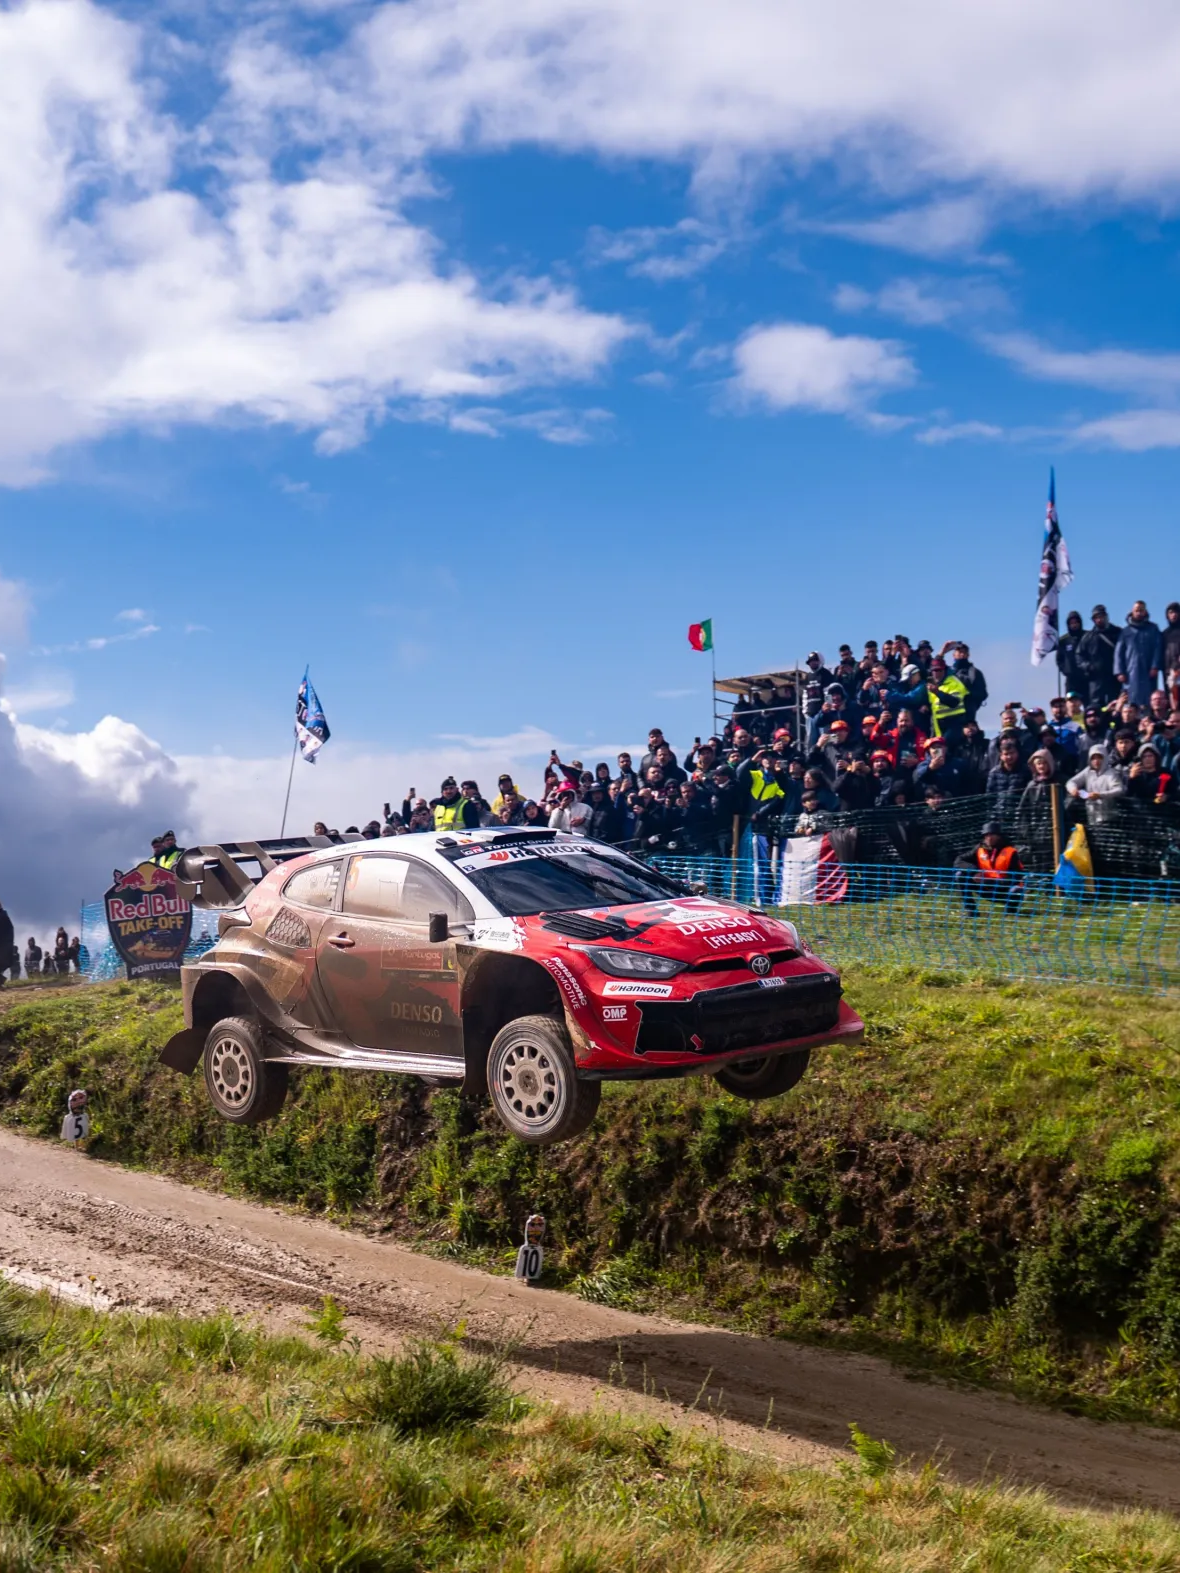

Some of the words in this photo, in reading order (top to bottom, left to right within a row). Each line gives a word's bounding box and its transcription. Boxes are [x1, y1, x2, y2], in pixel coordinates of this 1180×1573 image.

[109, 894, 150, 920] Red
[151, 893, 190, 916] Bull
[118, 916, 184, 937] TAKE-OFF
[676, 917, 751, 936] DENSO
[131, 961, 180, 975] PORTUGAL
[541, 959, 580, 1010] AUTOMOTIVE
[550, 956, 587, 1006] Panasonic
[392, 1001, 442, 1023] DENSO
[602, 1008, 627, 1018] OMP
[74, 1117, 83, 1139] 5
[522, 1249, 539, 1277] 10
